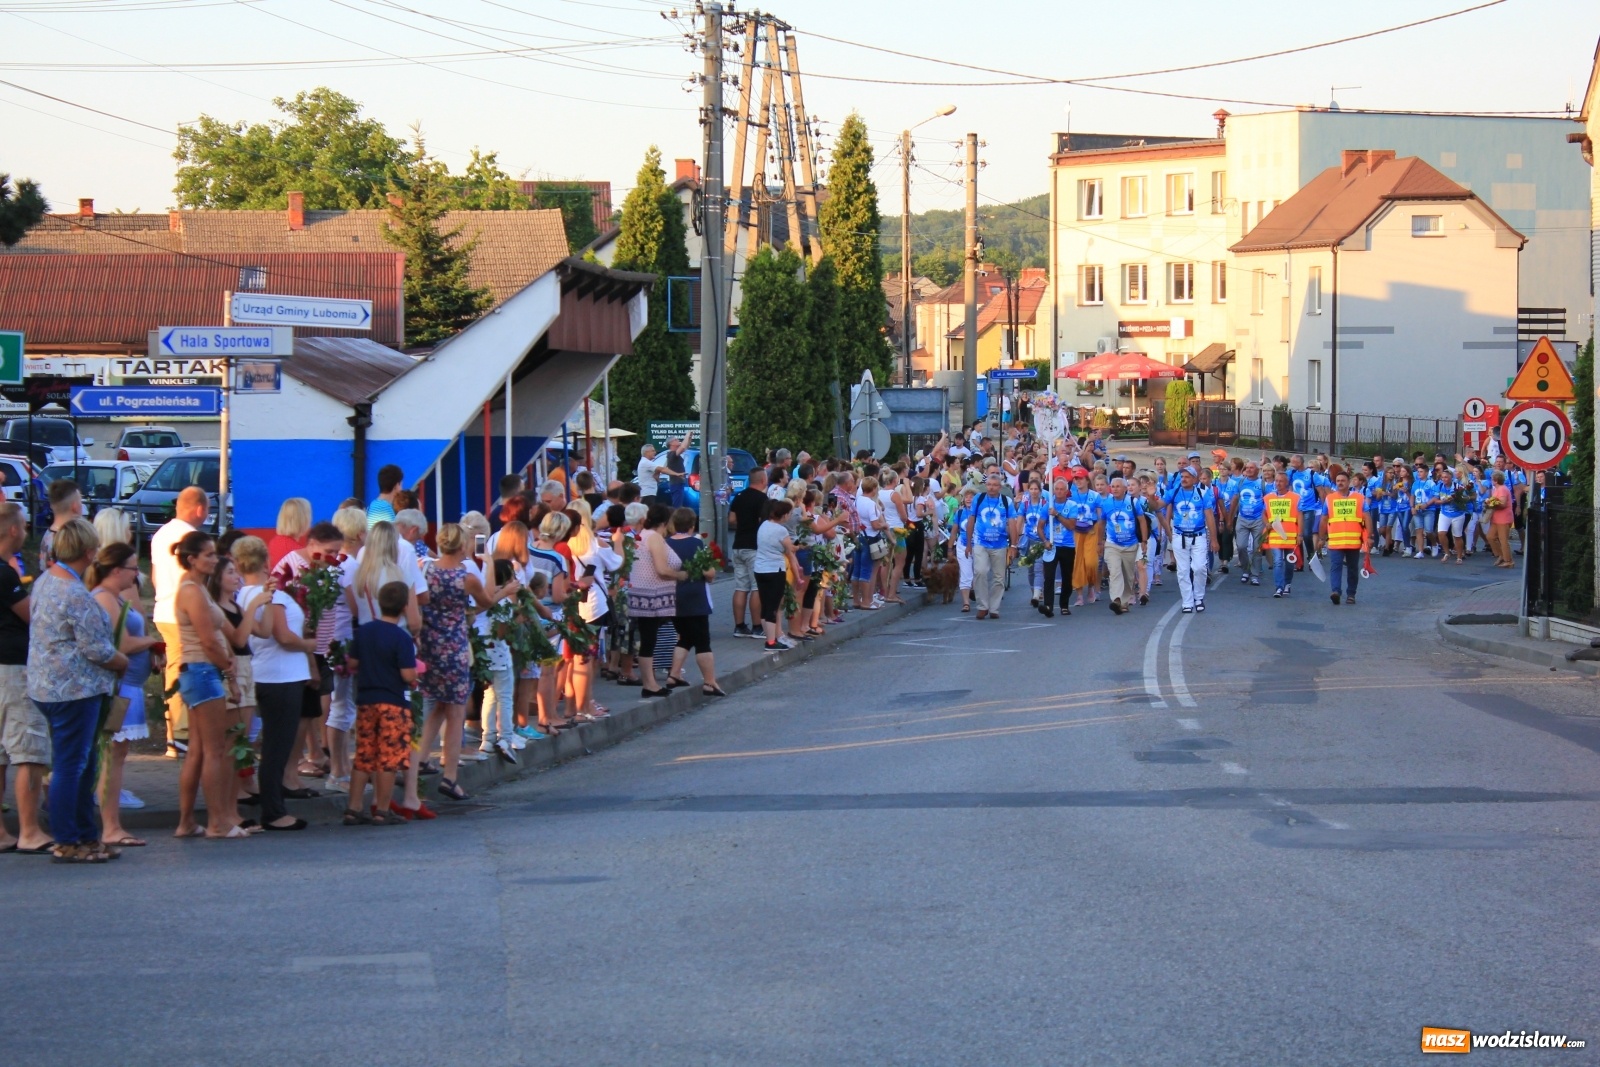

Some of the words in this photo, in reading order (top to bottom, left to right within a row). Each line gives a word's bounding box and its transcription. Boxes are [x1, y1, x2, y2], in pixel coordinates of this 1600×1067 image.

[243, 303, 273, 317] Urząd
[276, 305, 310, 319] Gminy
[312, 305, 357, 319] Lubomia
[180, 334, 208, 348] Hala
[214, 334, 270, 350] Sportowa
[116, 360, 224, 375] TARTAK
[99, 396, 112, 406] ul.
[116, 396, 200, 408] Pogrzebieńska
[1513, 418, 1562, 452] 30
